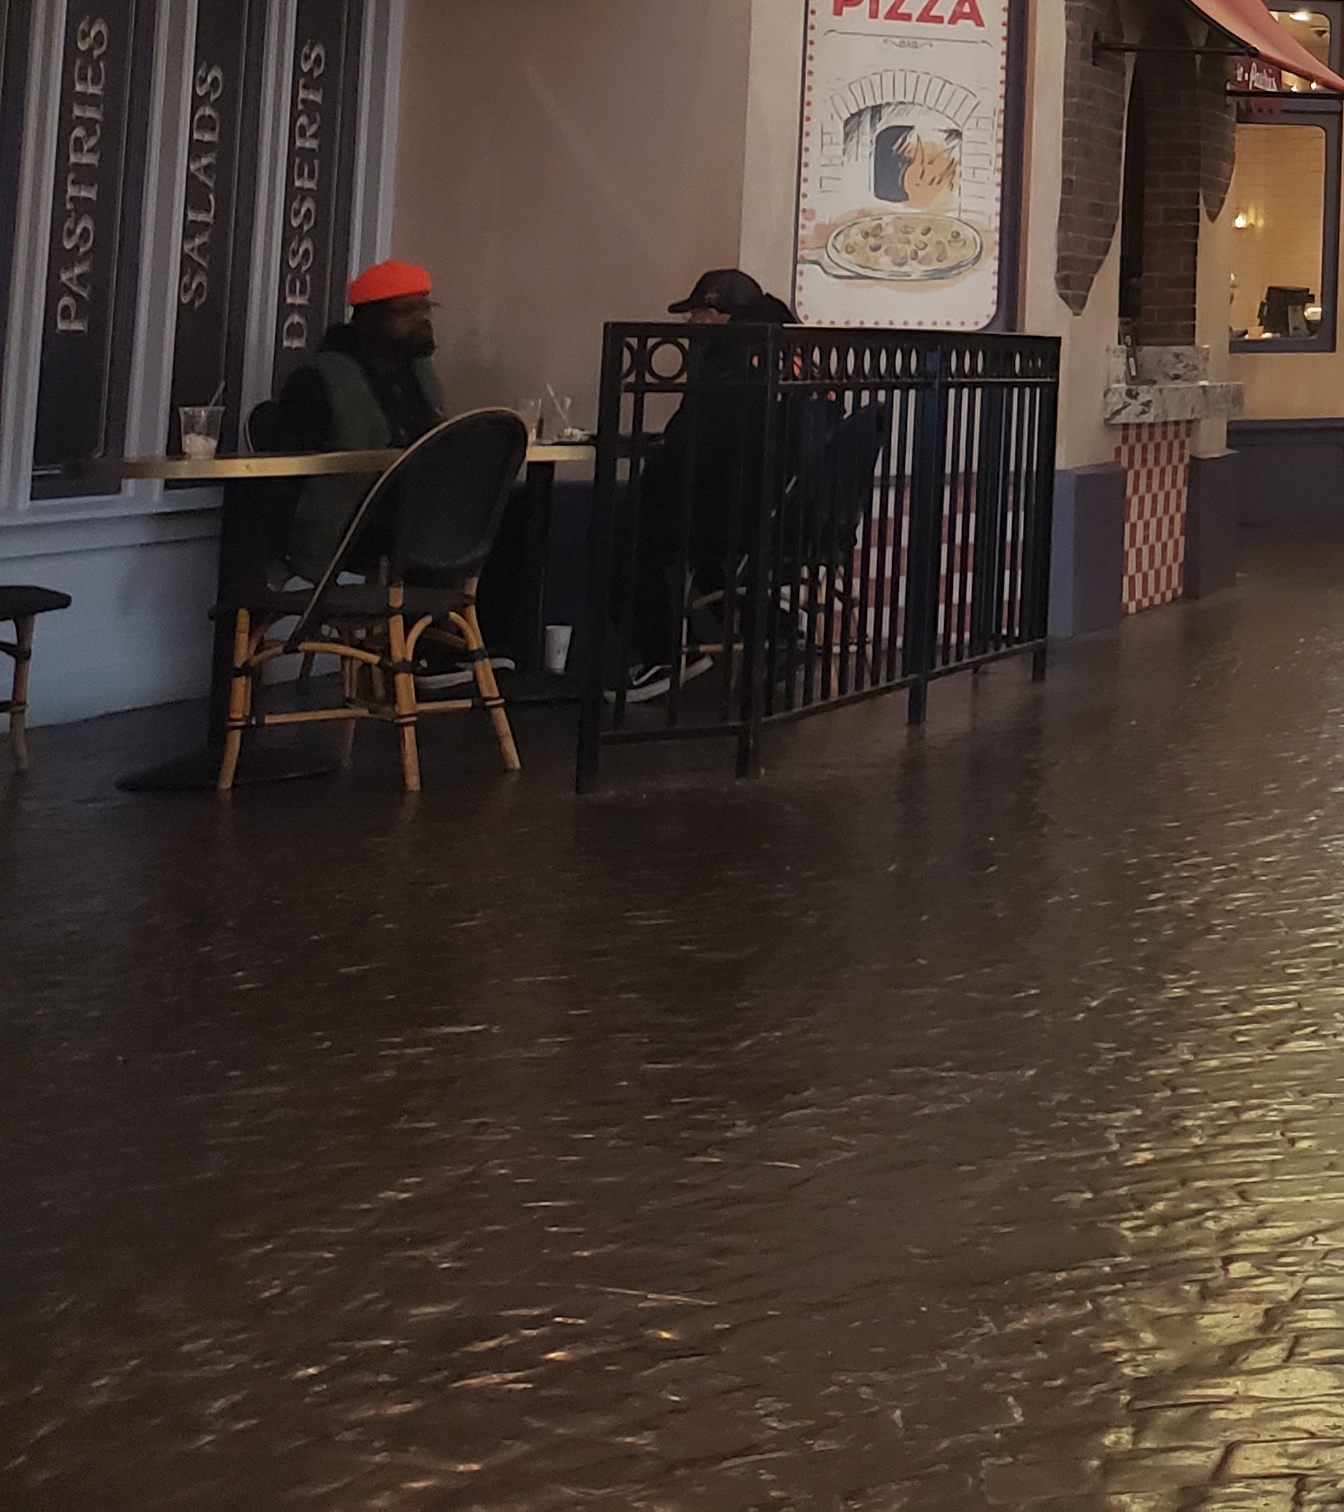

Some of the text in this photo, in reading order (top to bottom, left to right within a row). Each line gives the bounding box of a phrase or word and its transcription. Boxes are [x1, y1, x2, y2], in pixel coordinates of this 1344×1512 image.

[57, 15, 109, 333] PASTRIES
[180, 60, 223, 310] SALADS
[283, 39, 326, 350] DESSERTS
